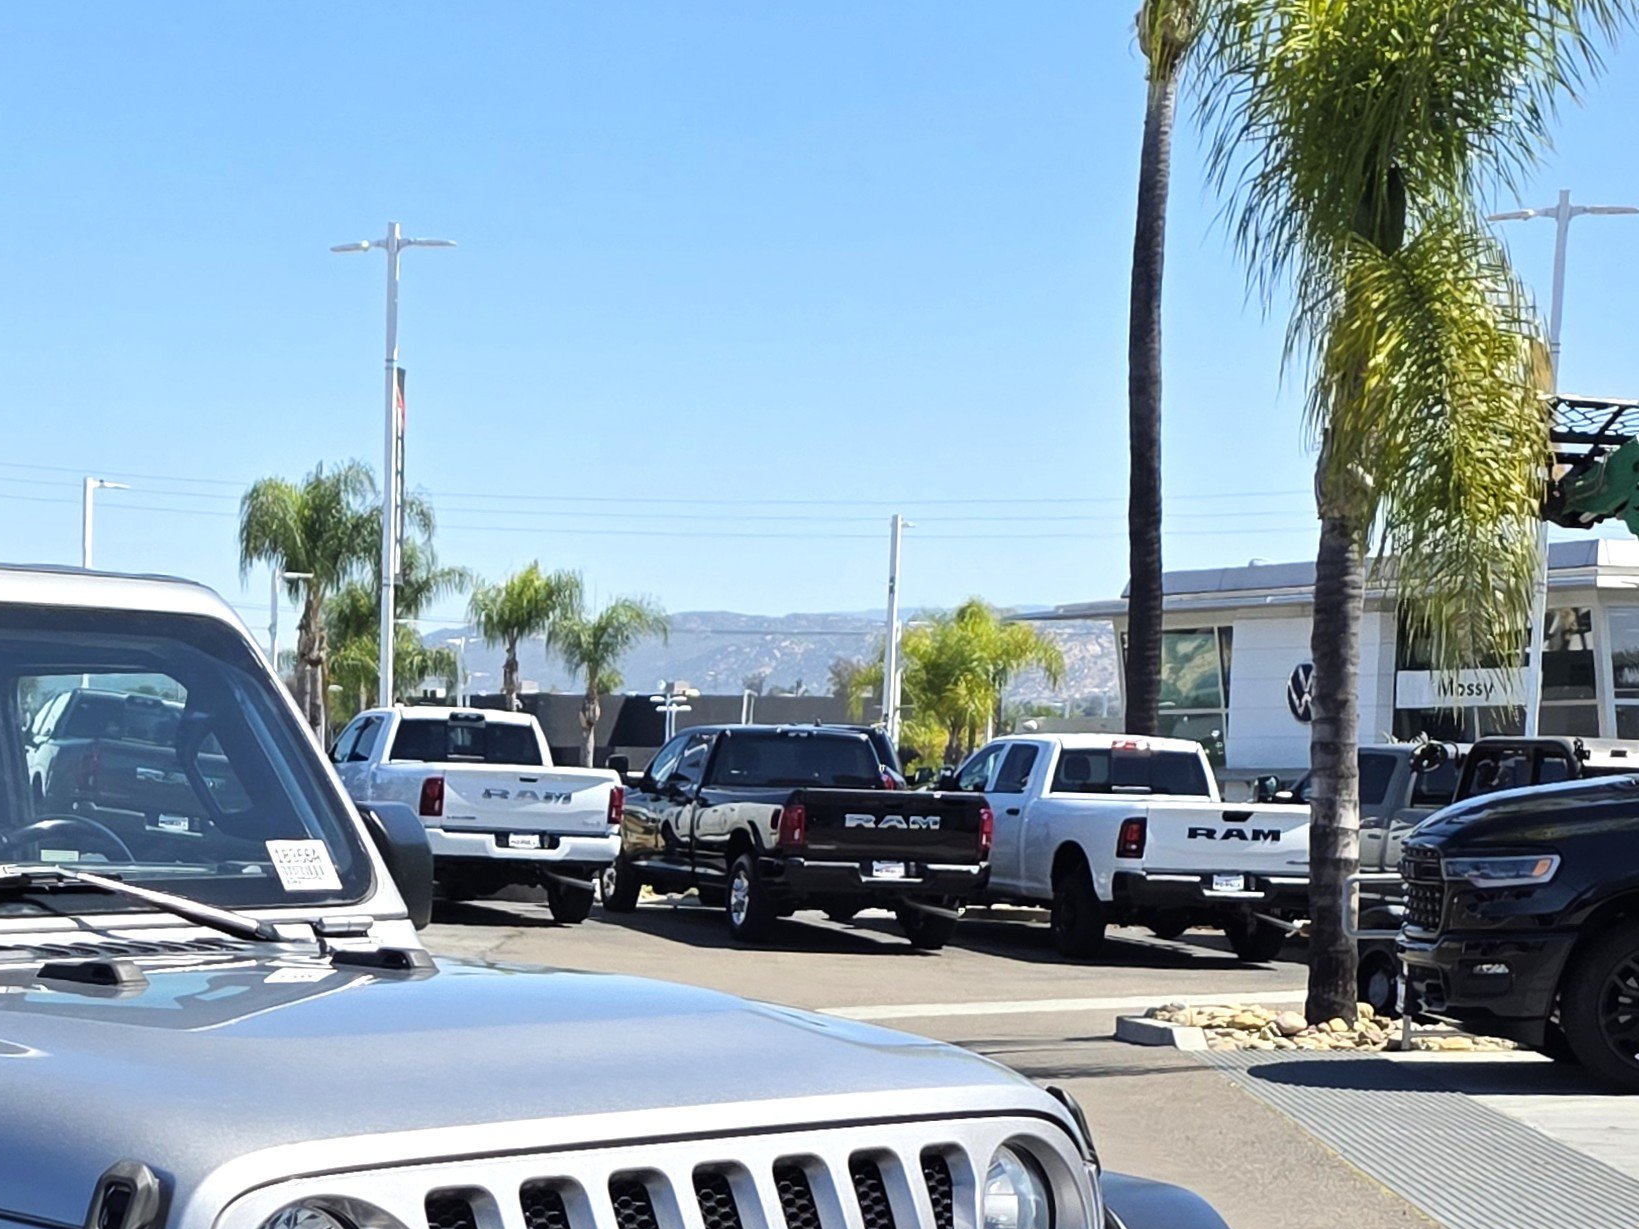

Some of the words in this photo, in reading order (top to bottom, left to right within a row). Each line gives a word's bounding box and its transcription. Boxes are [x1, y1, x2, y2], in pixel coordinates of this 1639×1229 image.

[1438, 677, 1495, 702] Mossy
[482, 788, 572, 804] RAM
[844, 813, 942, 829] RAM
[1187, 827, 1282, 842] RAM
